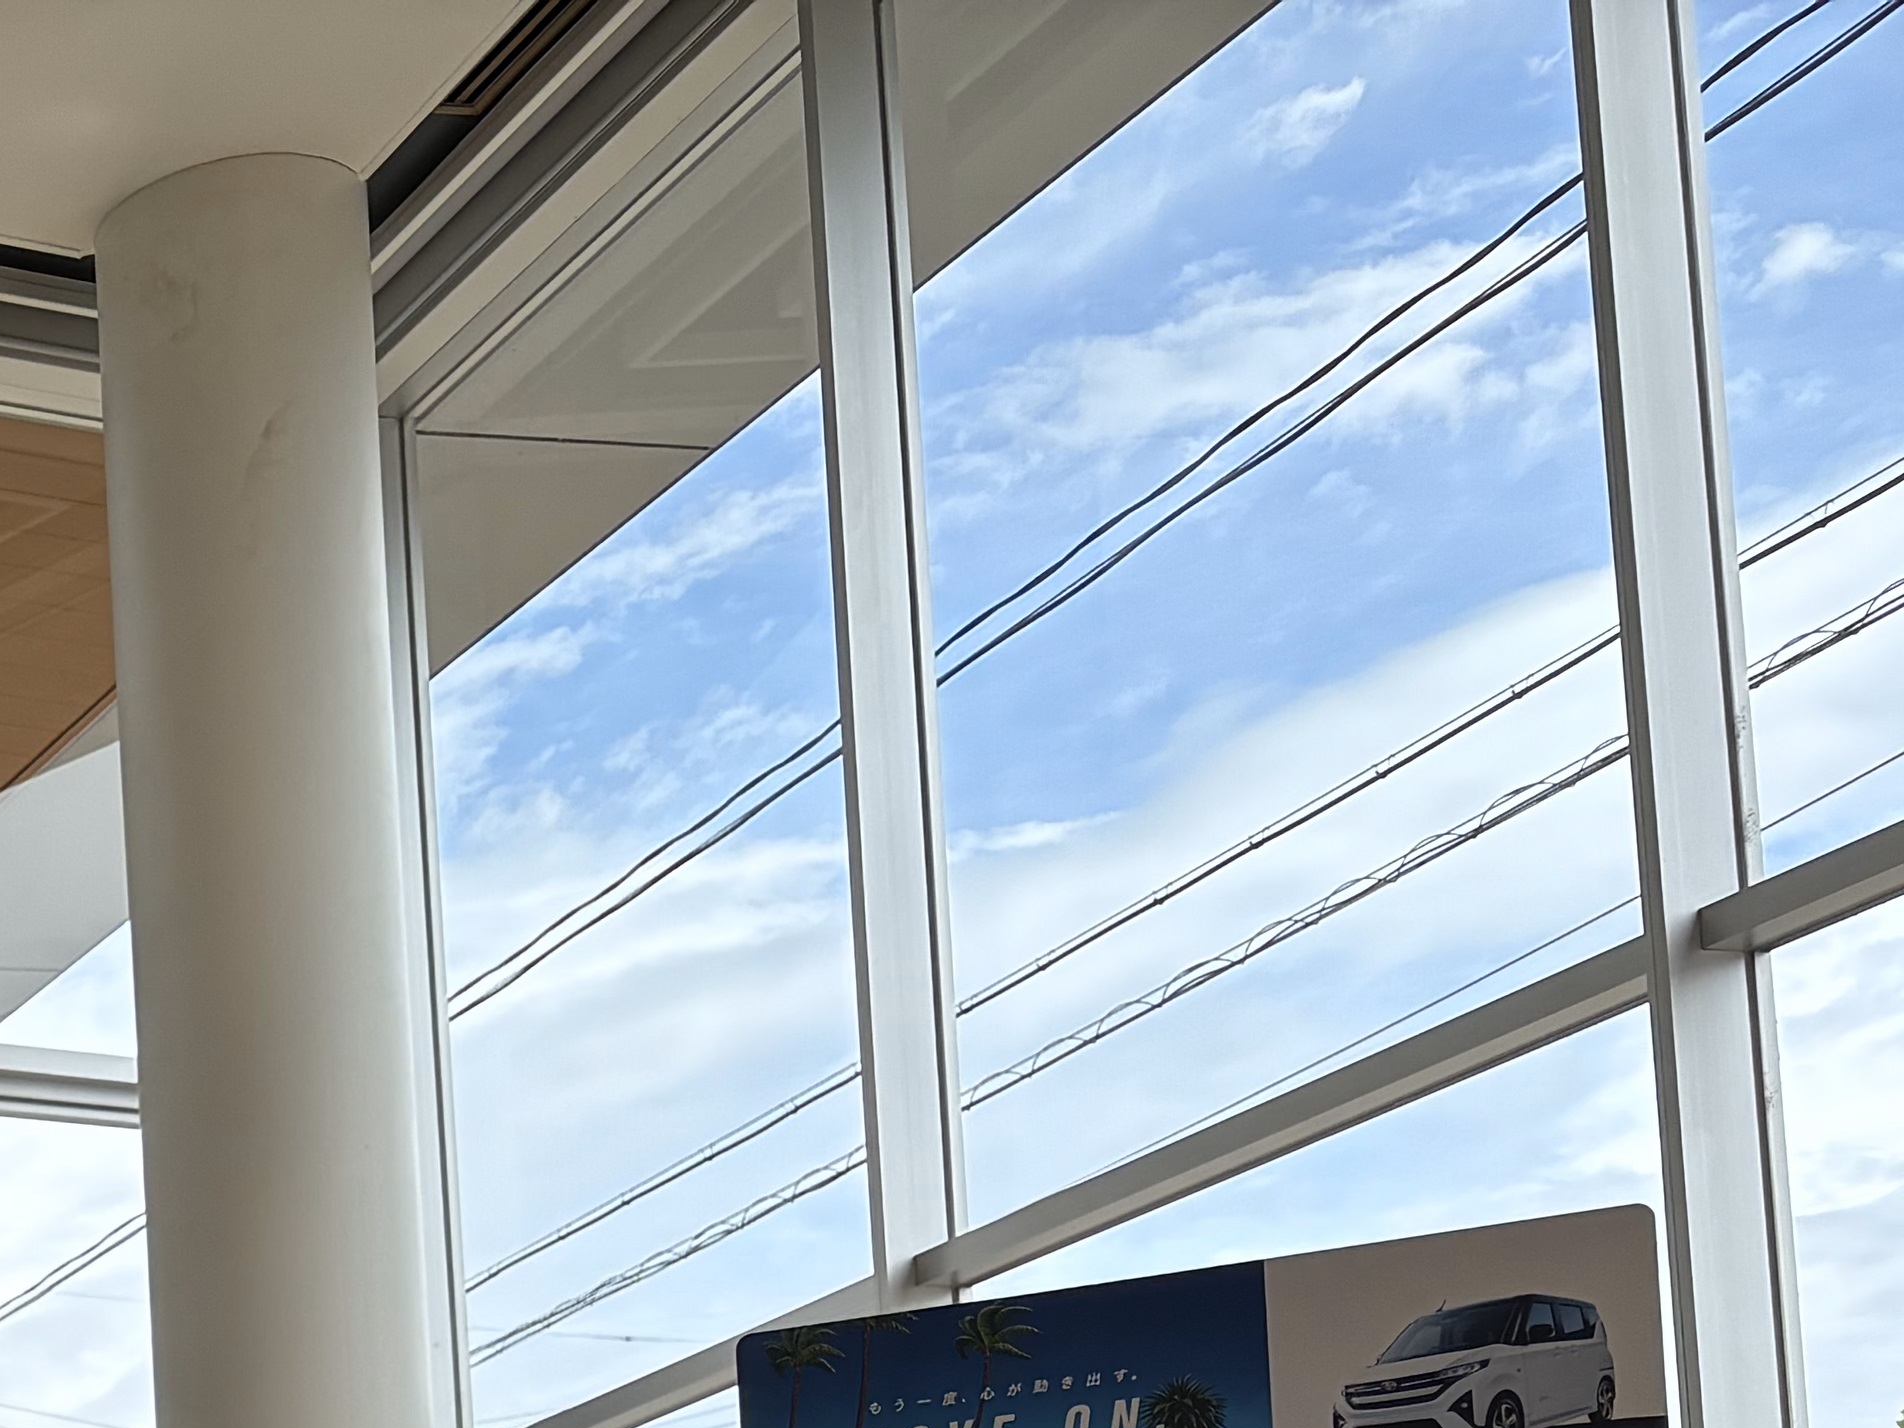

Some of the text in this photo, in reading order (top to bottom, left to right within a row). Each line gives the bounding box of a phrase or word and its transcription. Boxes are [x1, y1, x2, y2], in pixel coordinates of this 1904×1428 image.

[868, 1369, 1140, 1417] もう一度、心が動き出す。
